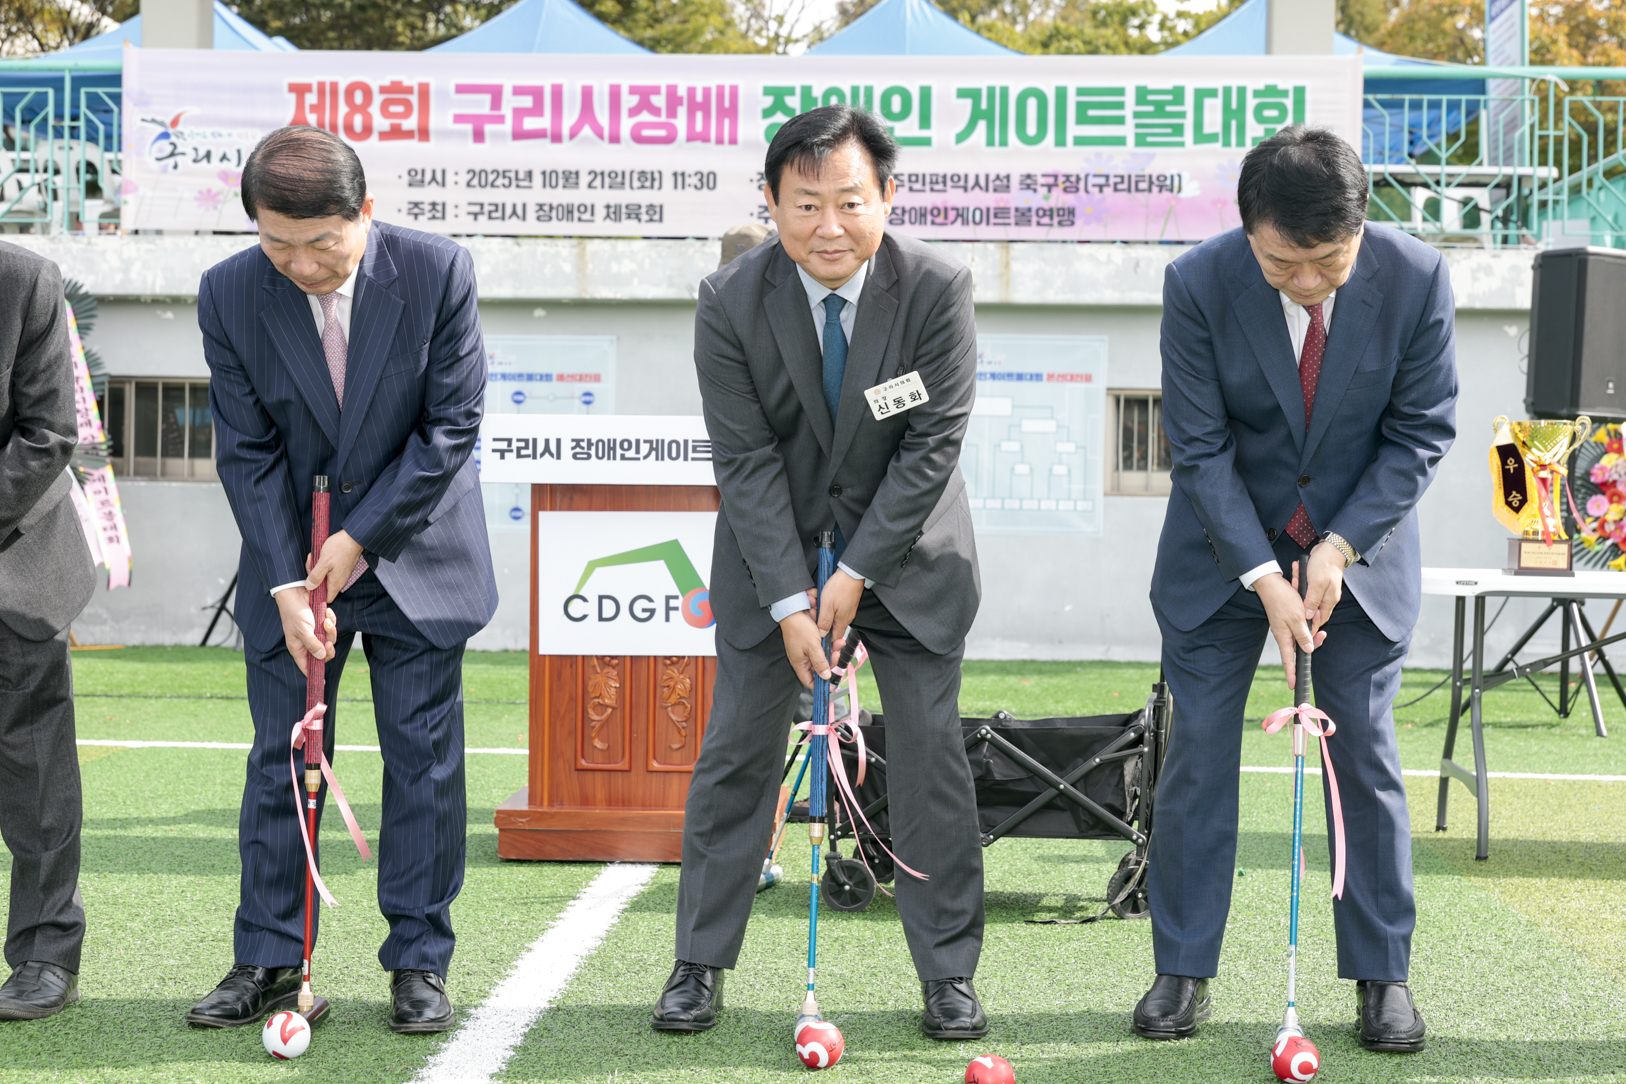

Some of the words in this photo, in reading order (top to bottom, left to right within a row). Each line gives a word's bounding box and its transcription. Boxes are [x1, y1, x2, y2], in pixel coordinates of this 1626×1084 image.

[288, 80, 430, 142] 제8회
[453, 83, 740, 146] 구리시장배
[954, 85, 1306, 149] 게이트볼대회
[466, 168, 533, 189] 2025년
[540, 169, 580, 190] 10월
[587, 169, 663, 191] 21일(화)
[672, 170, 718, 191] 11:30
[1019, 173, 1183, 194] 축구장(구리타워)
[466, 202, 527, 222] 구리시
[535, 203, 596, 223] 장애인
[603, 203, 664, 224] 체육회
[888, 206, 1076, 227] 장애인게이트볼연맹
[877, 389, 922, 415] 신동화
[491, 437, 562, 461] 구리시
[570, 438, 713, 462] 장애인게이트
[1504, 457, 1523, 508] 우승
[563, 593, 680, 623] CDGF
[266, 1011, 306, 1047] 2
